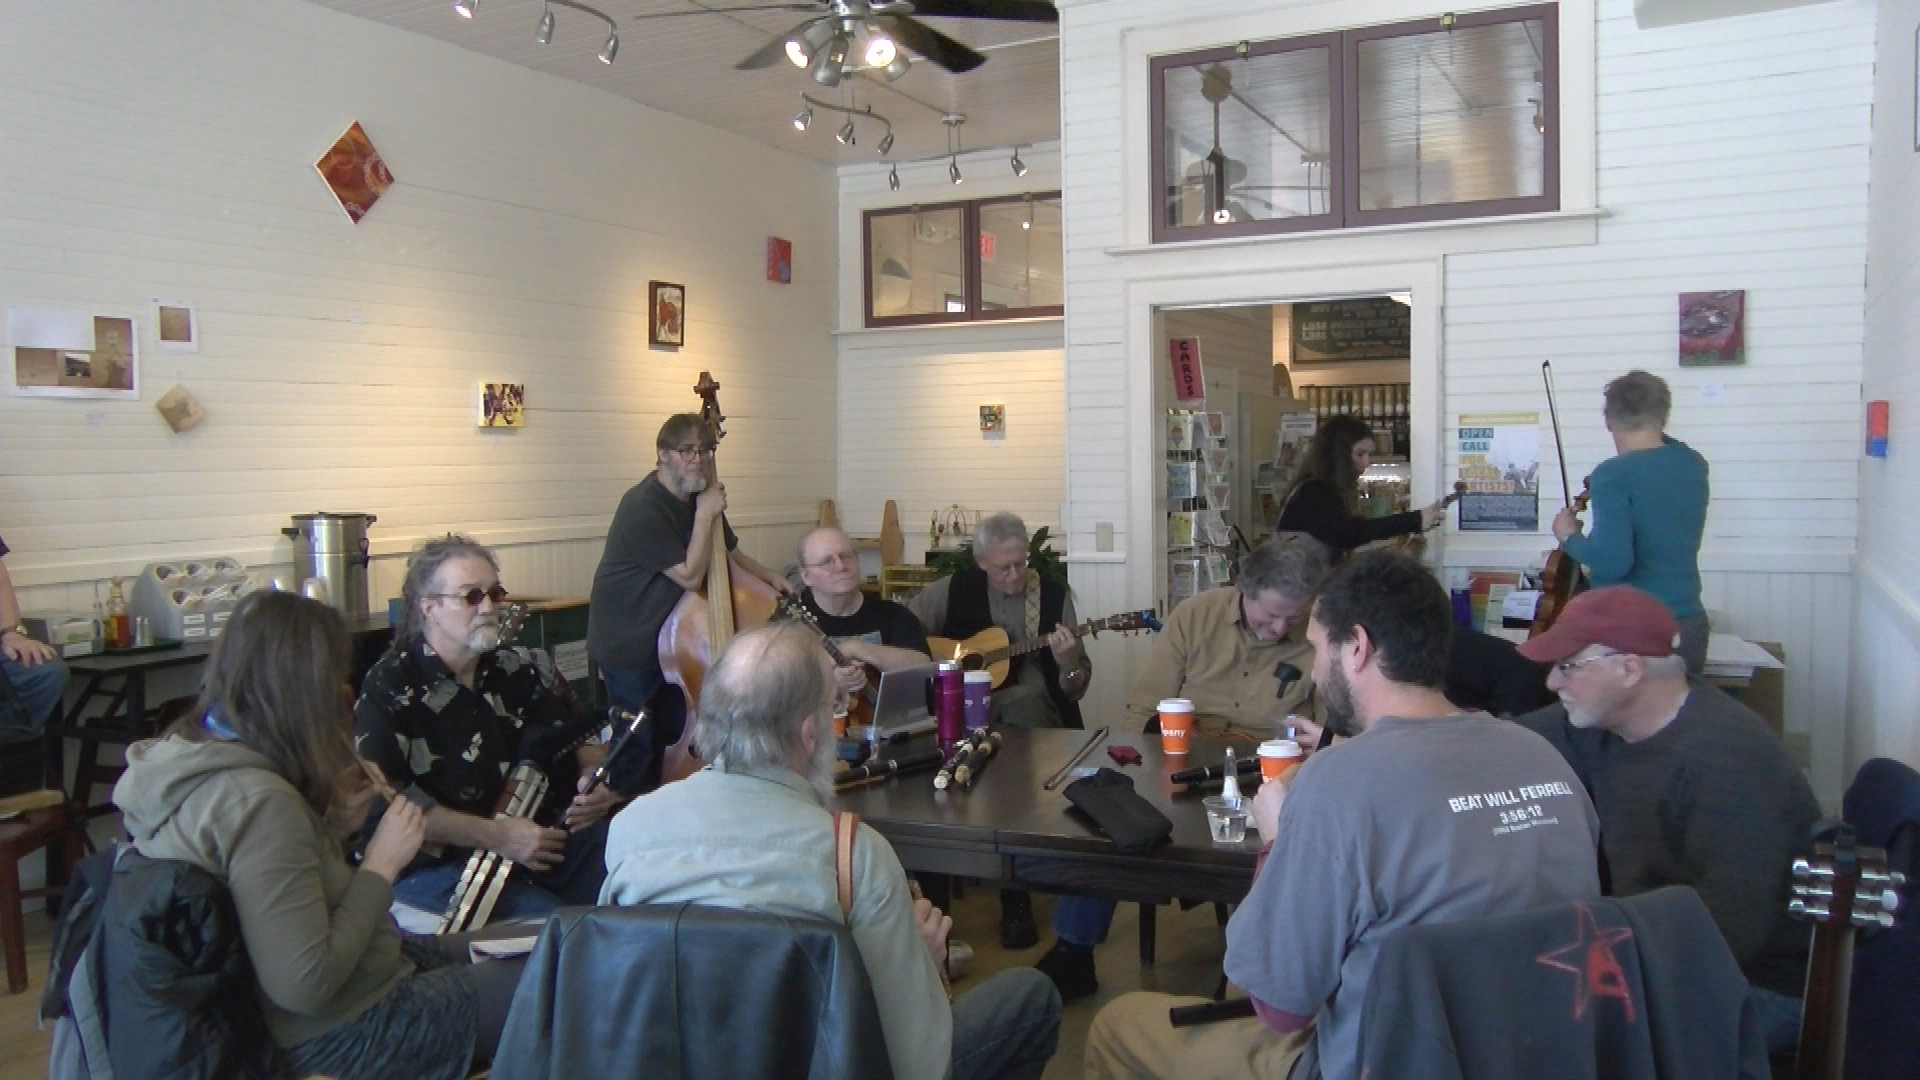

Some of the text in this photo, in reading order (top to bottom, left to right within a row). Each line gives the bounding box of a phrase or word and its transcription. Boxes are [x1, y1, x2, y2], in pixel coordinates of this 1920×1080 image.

[1179, 341, 1194, 397] CARDS
[1462, 428, 1492, 438] OPEN
[1462, 441, 1488, 451] CALL
[1448, 781, 1573, 813] BEAT WILL FERRELL
